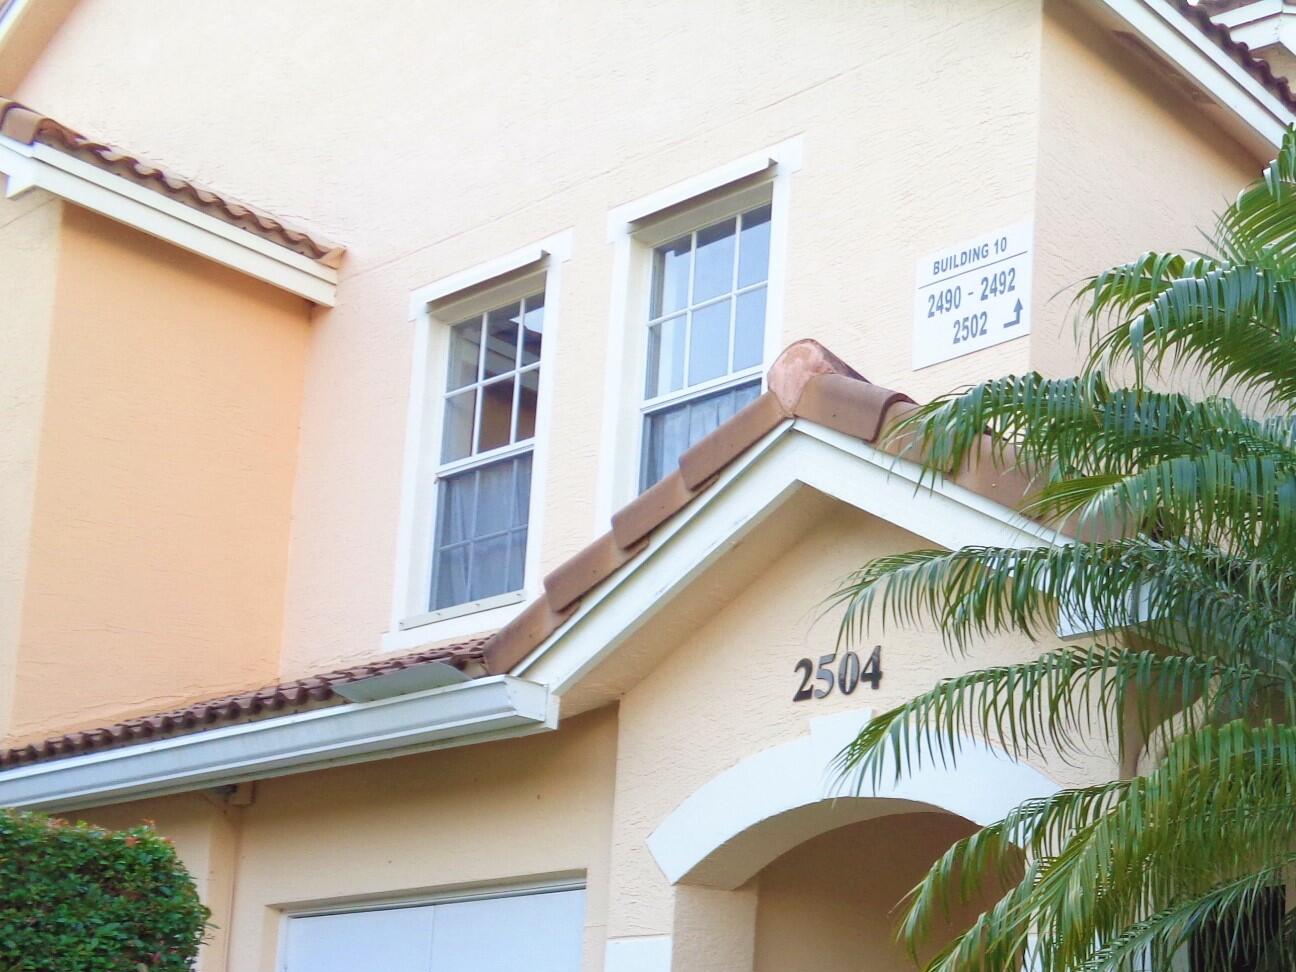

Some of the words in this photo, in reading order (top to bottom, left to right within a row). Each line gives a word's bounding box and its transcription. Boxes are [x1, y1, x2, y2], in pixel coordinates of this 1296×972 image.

[933, 243, 989, 275] BUILDING
[994, 236, 1007, 254] 10
[927, 285, 961, 318] 2490
[980, 267, 1016, 301] 2492
[952, 311, 988, 344] 2502
[792, 645, 883, 702] 2504
